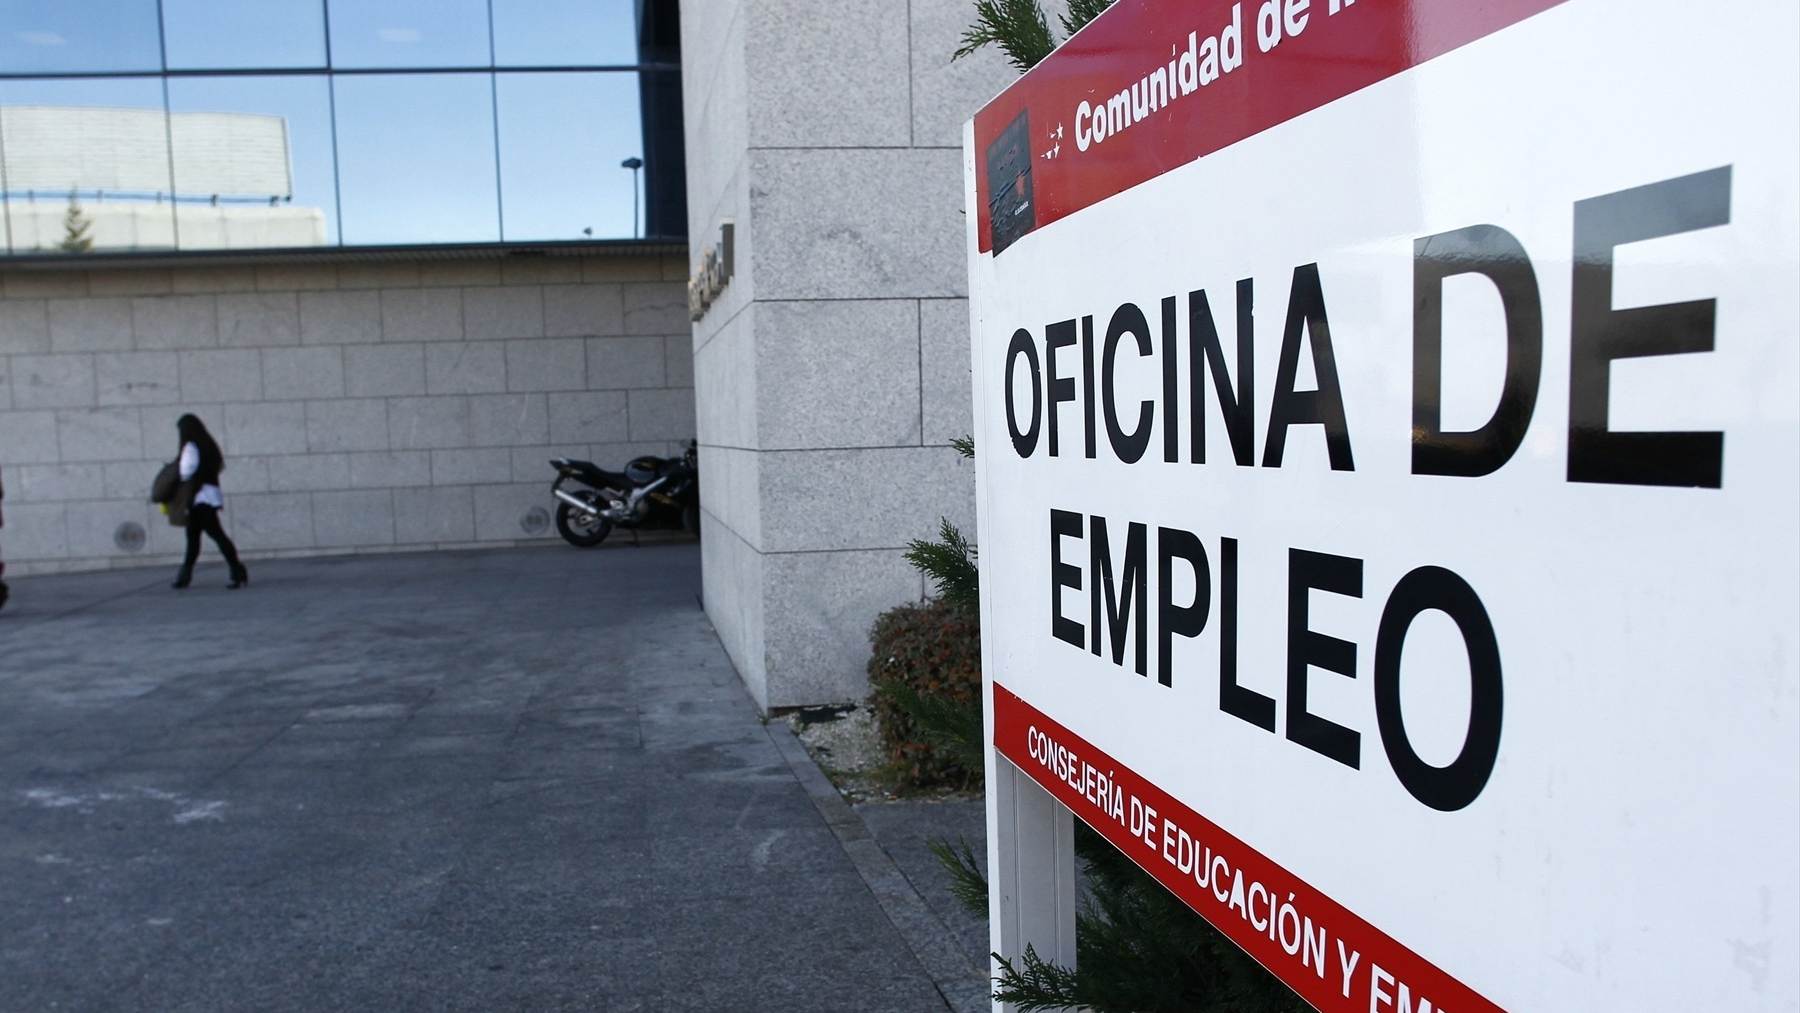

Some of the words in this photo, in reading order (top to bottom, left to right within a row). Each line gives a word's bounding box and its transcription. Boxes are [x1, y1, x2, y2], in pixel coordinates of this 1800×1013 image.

[1074, 2, 1243, 152] Comunidad
[1256, 0, 1311, 53] de
[1004, 262, 1356, 472] OFICINA
[1410, 165, 1732, 490] DE
[1049, 508, 1505, 813] EMPLEO
[1027, 724, 1126, 827] CONSEJERÍA
[1130, 794, 1159, 851] DE
[1163, 818, 1327, 979] EDUCACIÓN
[1336, 937, 1361, 999] Y
